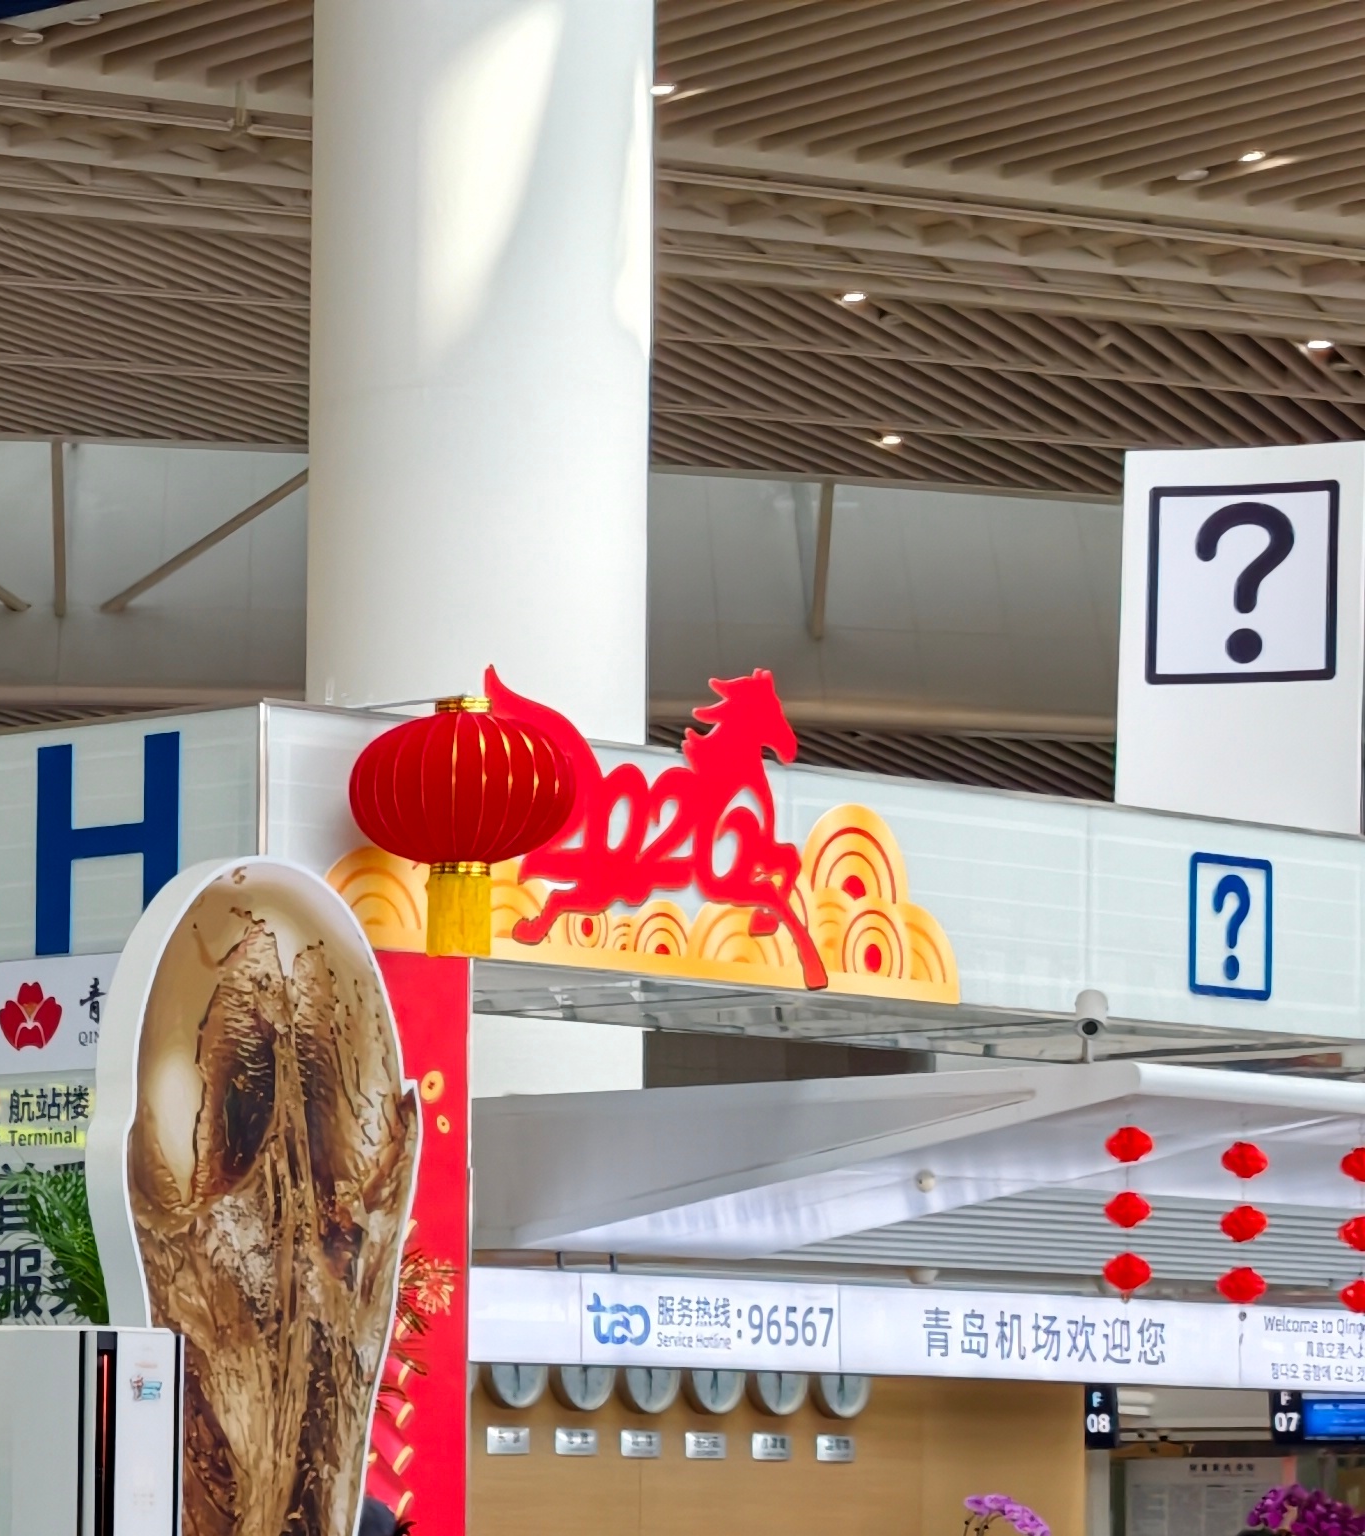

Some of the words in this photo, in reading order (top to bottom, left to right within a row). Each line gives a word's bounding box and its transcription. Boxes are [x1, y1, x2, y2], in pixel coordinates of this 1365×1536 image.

[8, 1086, 89, 1123] 航站楼
[8, 1126, 77, 1147] Terminal
[657, 1295, 731, 1328] 服务热线
[1263, 1314, 1318, 1333] Welcome
[1322, 1319, 1333, 1333] to
[922, 1306, 1167, 1366] 青岛机场欢迎您
[1092, 1392, 1103, 1408] F
[1086, 1413, 1110, 1433] 08
[1274, 1412, 1299, 1432] 07
